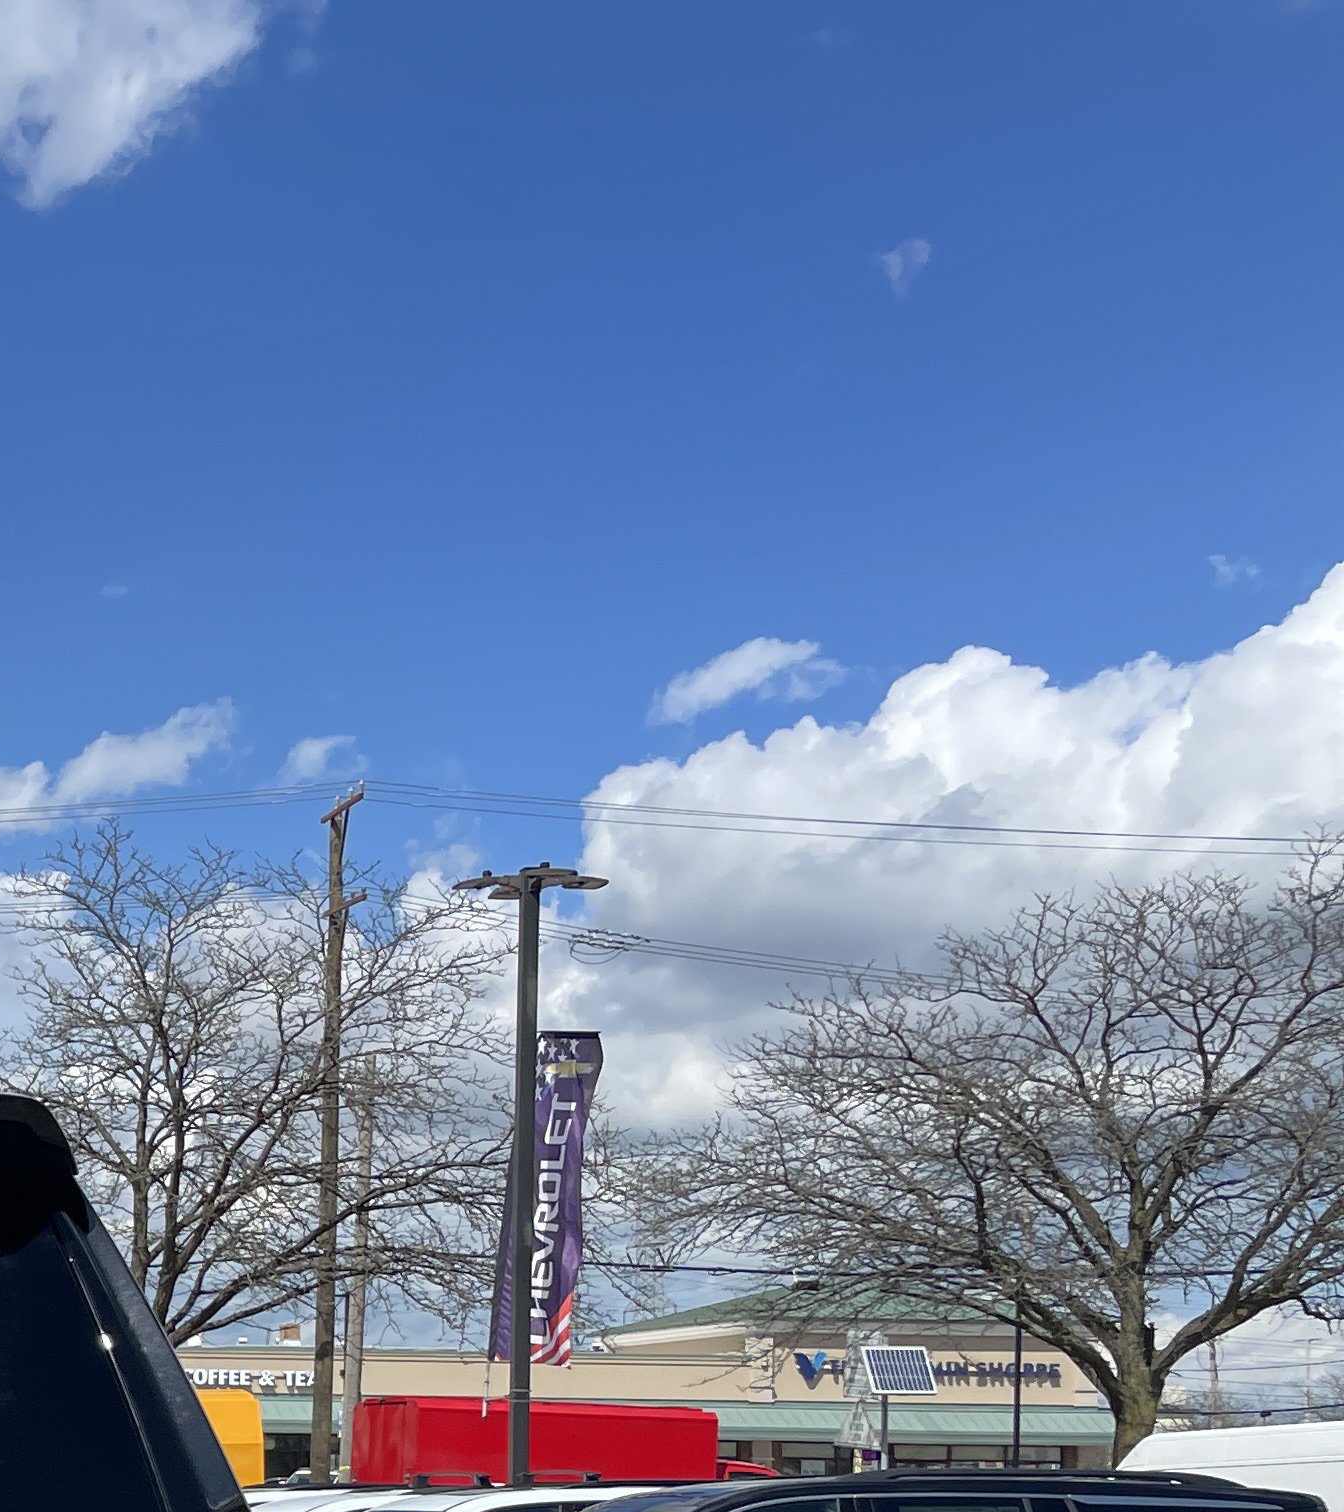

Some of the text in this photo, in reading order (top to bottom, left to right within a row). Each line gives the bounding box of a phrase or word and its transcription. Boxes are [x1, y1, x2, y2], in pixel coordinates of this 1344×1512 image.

[529, 1093, 576, 1345] CHEVROLET
[184, 1368, 252, 1386] COFFEE
[258, 1369, 275, 1387] &
